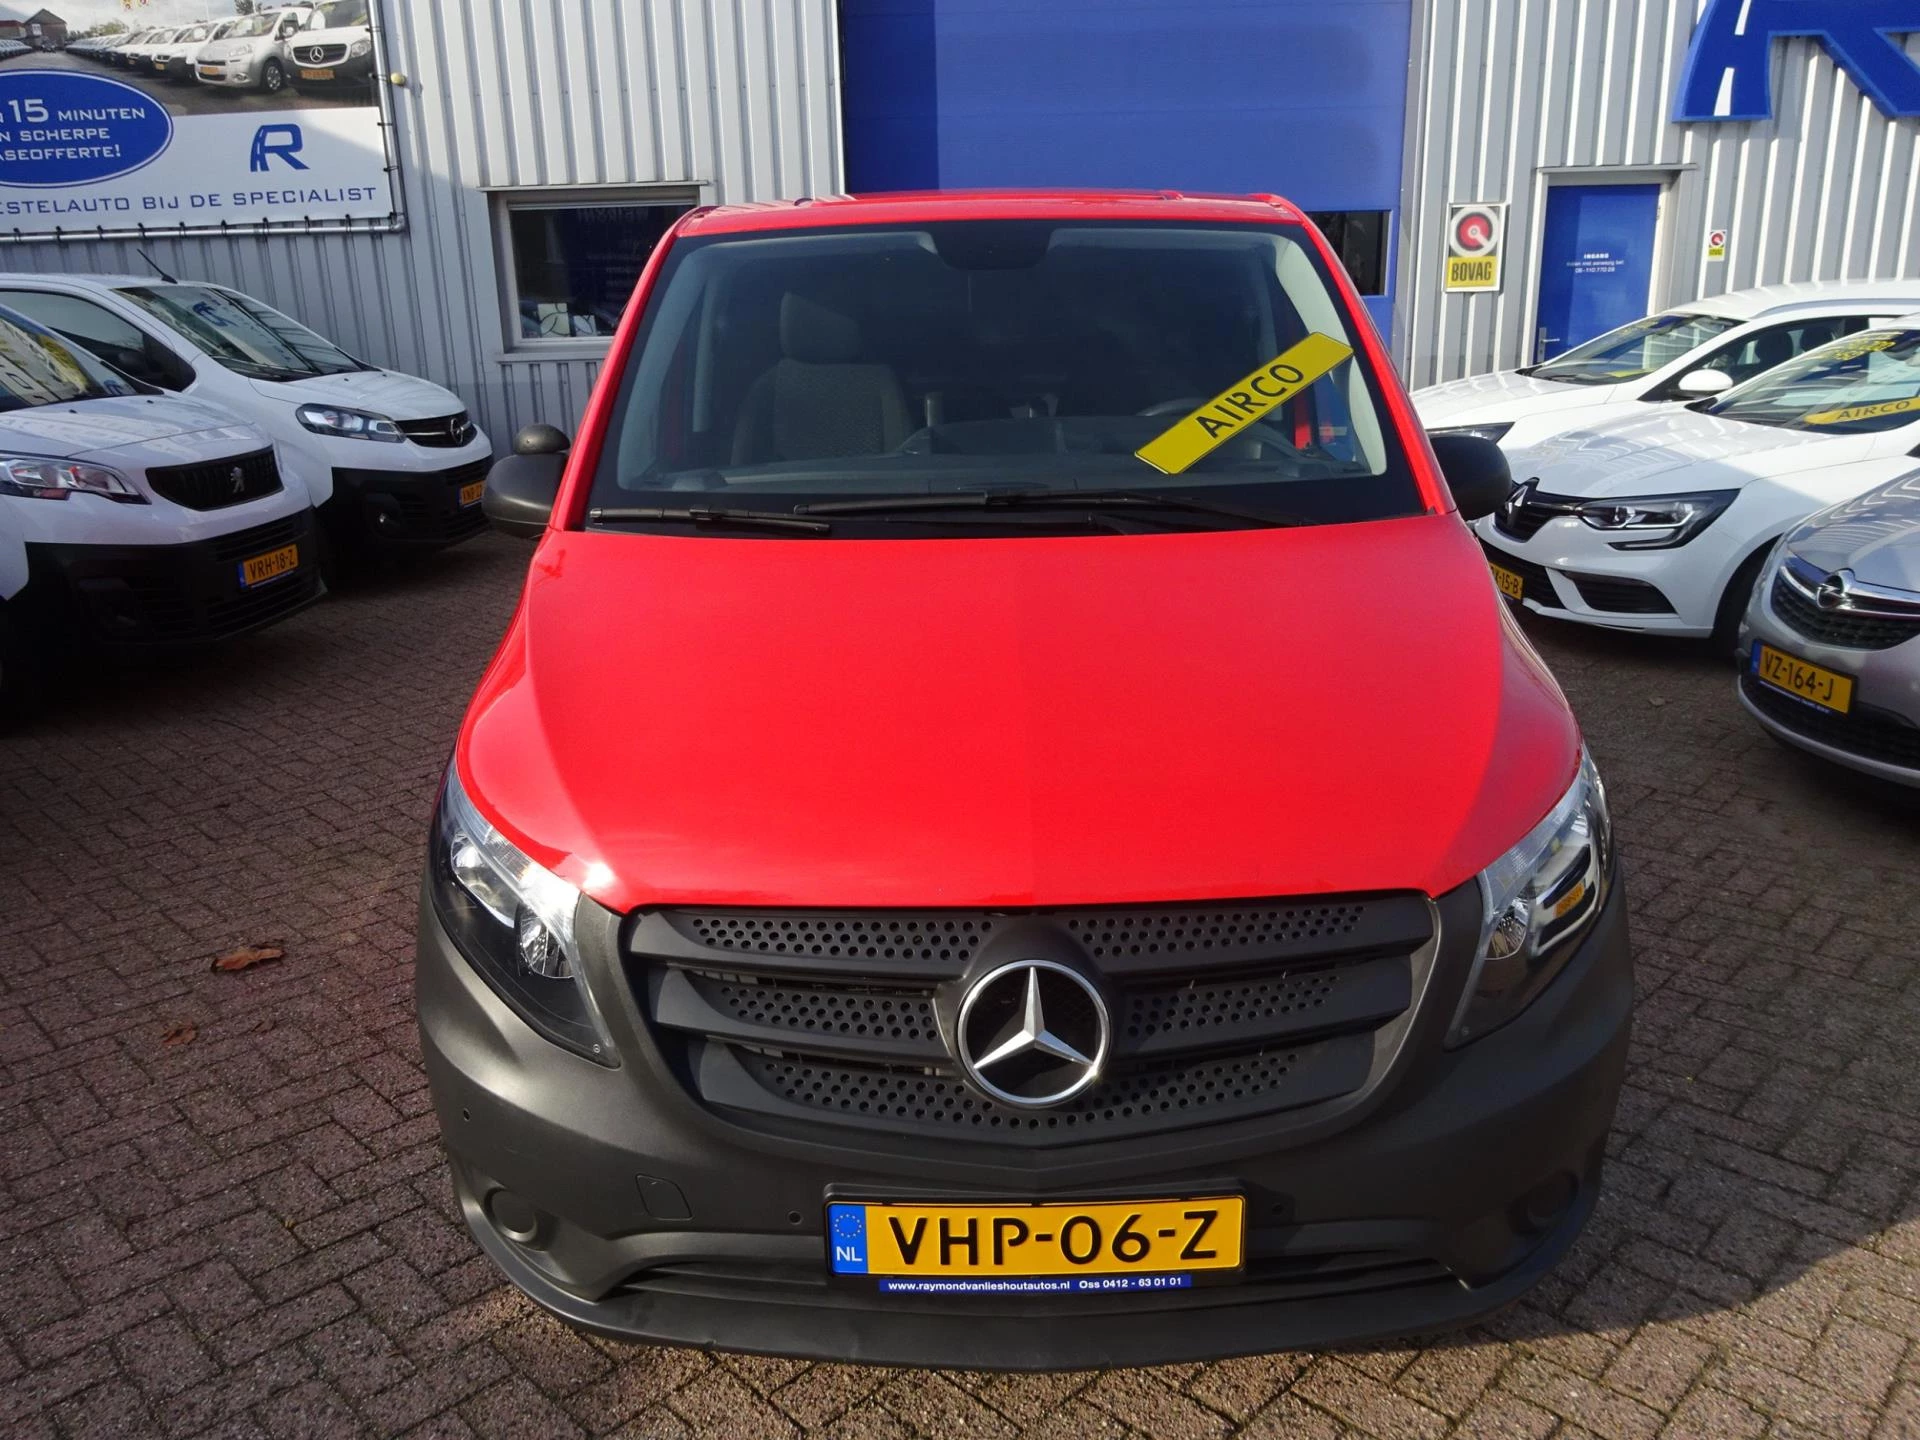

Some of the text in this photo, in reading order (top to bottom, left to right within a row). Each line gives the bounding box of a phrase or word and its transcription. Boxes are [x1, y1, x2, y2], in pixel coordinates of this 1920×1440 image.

[8, 99, 49, 123] 15
[58, 108, 145, 121] MINUTEN
[20, 127, 110, 142] SCHERPE
[143, 196, 179, 210] BIJ
[190, 194, 223, 208] DE
[233, 187, 376, 206] SPECIALIST
[1451, 262, 1492, 281] BOVAG
[1195, 364, 1304, 439] AIRCO
[1837, 401, 1911, 419] AIRCO
[250, 549, 294, 579] VRH-18-Z
[1765, 652, 1834, 702] VZ-164-J
[888, 1210, 1218, 1265] VHP-06-Z
[836, 1246, 863, 1262] NL
[888, 1280, 1070, 1292] www.raymondvanlieshoutautos.nl
[1079, 1280, 1100, 1289] Oss
[1103, 1279, 1129, 1288] 0412
[1138, 1278, 1152, 1287] 63
[1154, 1278, 1166, 1287] 01
[1170, 1277, 1182, 1286] 01
